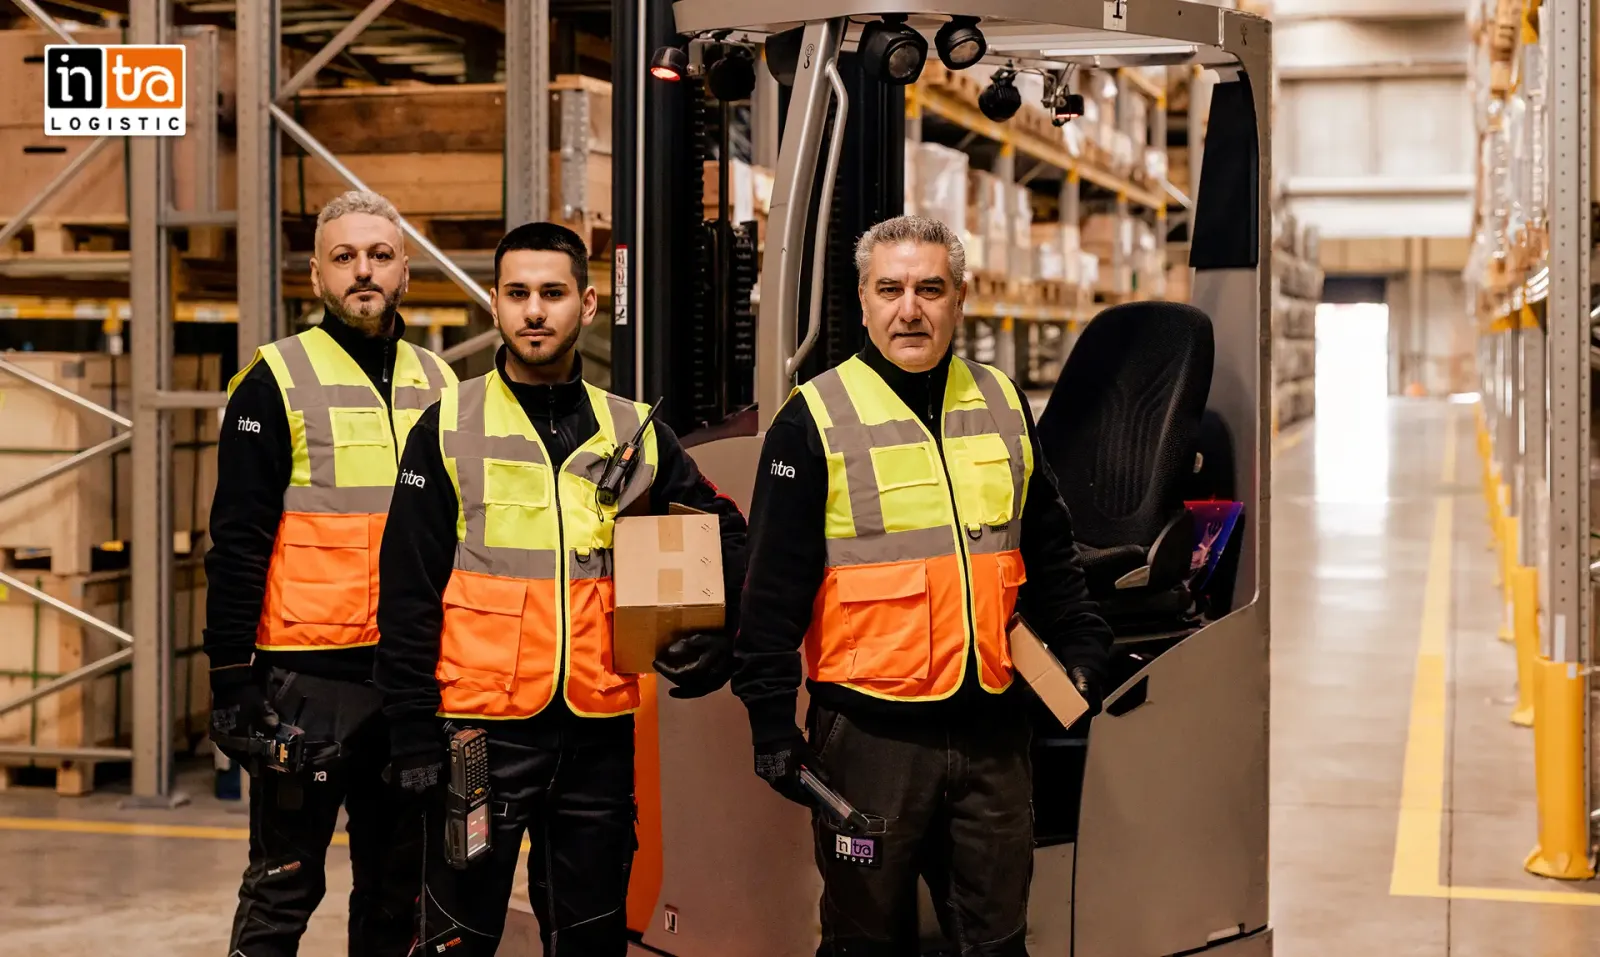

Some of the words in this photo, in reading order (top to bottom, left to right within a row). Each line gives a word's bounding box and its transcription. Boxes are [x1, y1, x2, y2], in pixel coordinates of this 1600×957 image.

[237, 415, 261, 434] intra
[400, 468, 426, 489] intra
[770, 459, 796, 479] intra
[838, 837, 872, 856] intra
